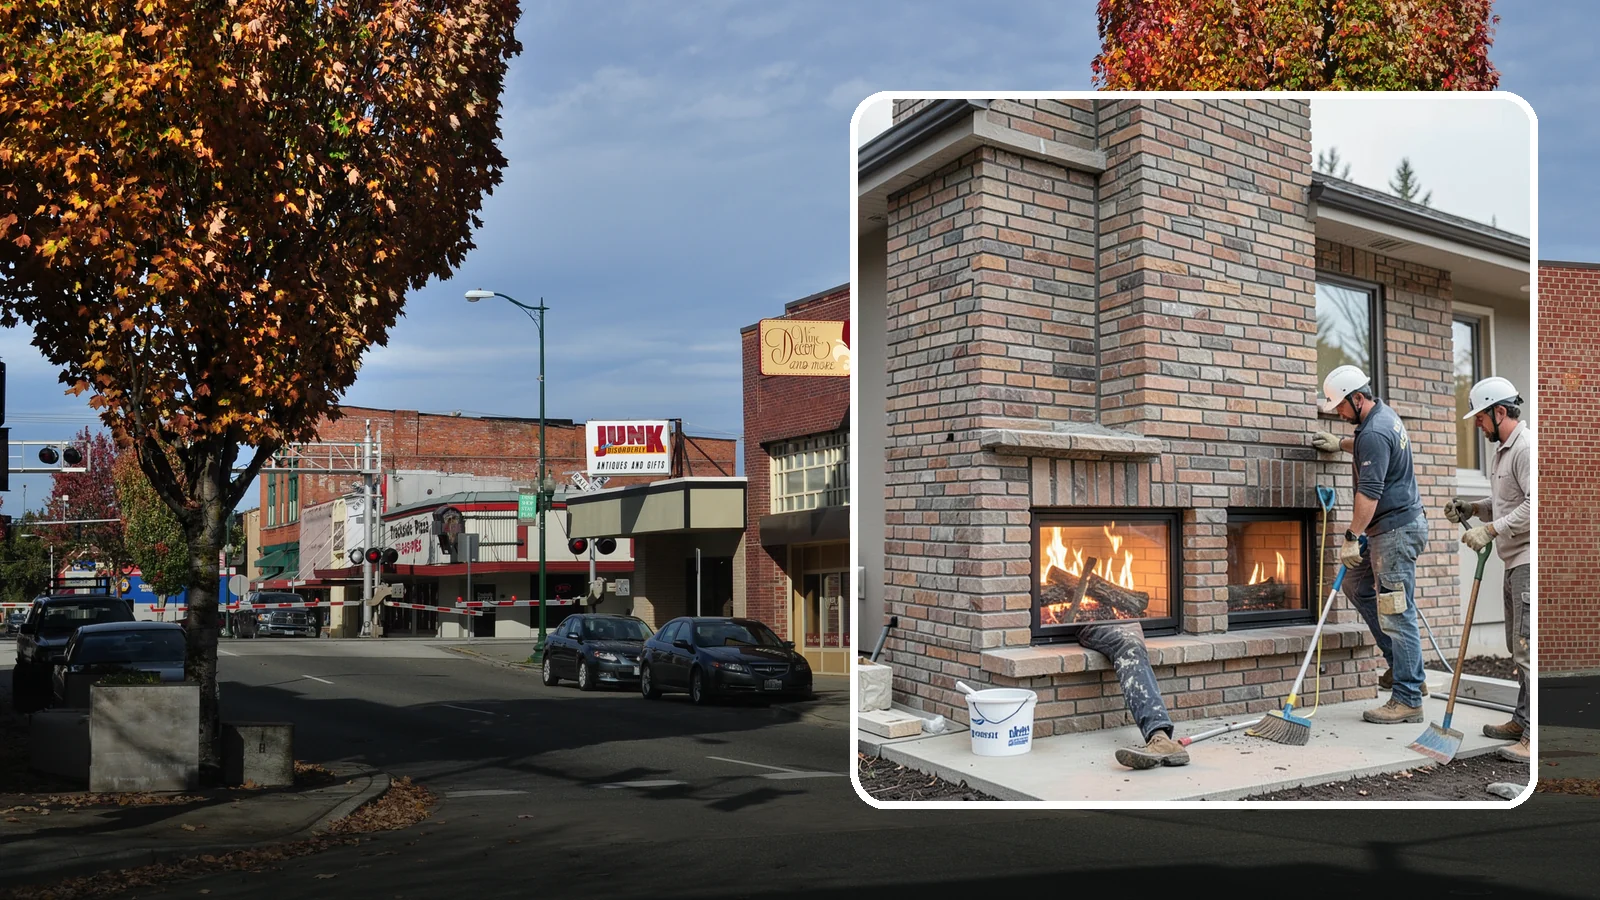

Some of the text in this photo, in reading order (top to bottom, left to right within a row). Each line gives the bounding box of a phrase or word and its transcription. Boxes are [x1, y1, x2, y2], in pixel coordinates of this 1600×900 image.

[765, 328, 831, 365] Decor
[595, 425, 665, 457] JUNK
[607, 446, 646, 454] DISORDERLY
[597, 461, 665, 470] ANTIQUES AND GIFTS
